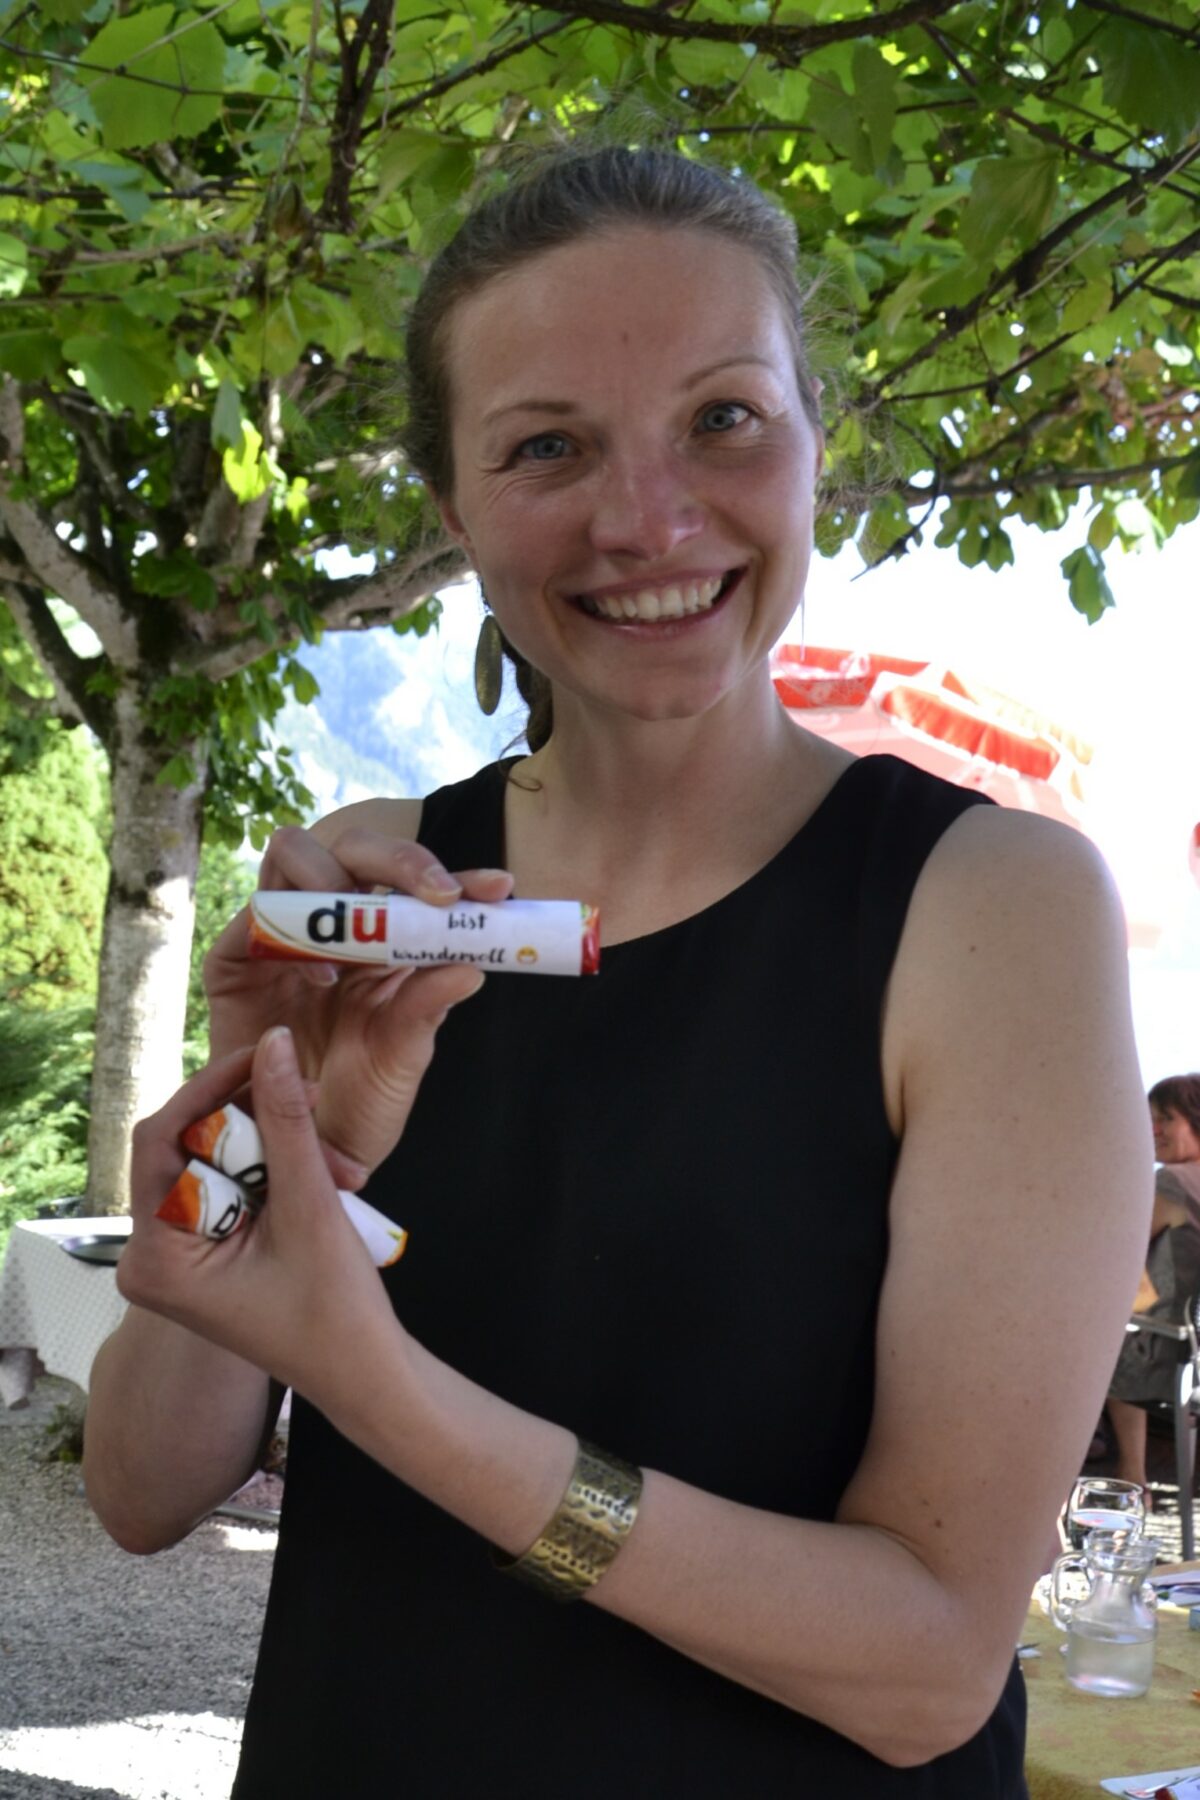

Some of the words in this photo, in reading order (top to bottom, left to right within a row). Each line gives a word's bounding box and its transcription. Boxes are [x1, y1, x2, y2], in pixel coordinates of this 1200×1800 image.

[306, 899, 387, 944] du
[447, 911, 487, 930] bist
[391, 946, 506, 964] wundervoll
